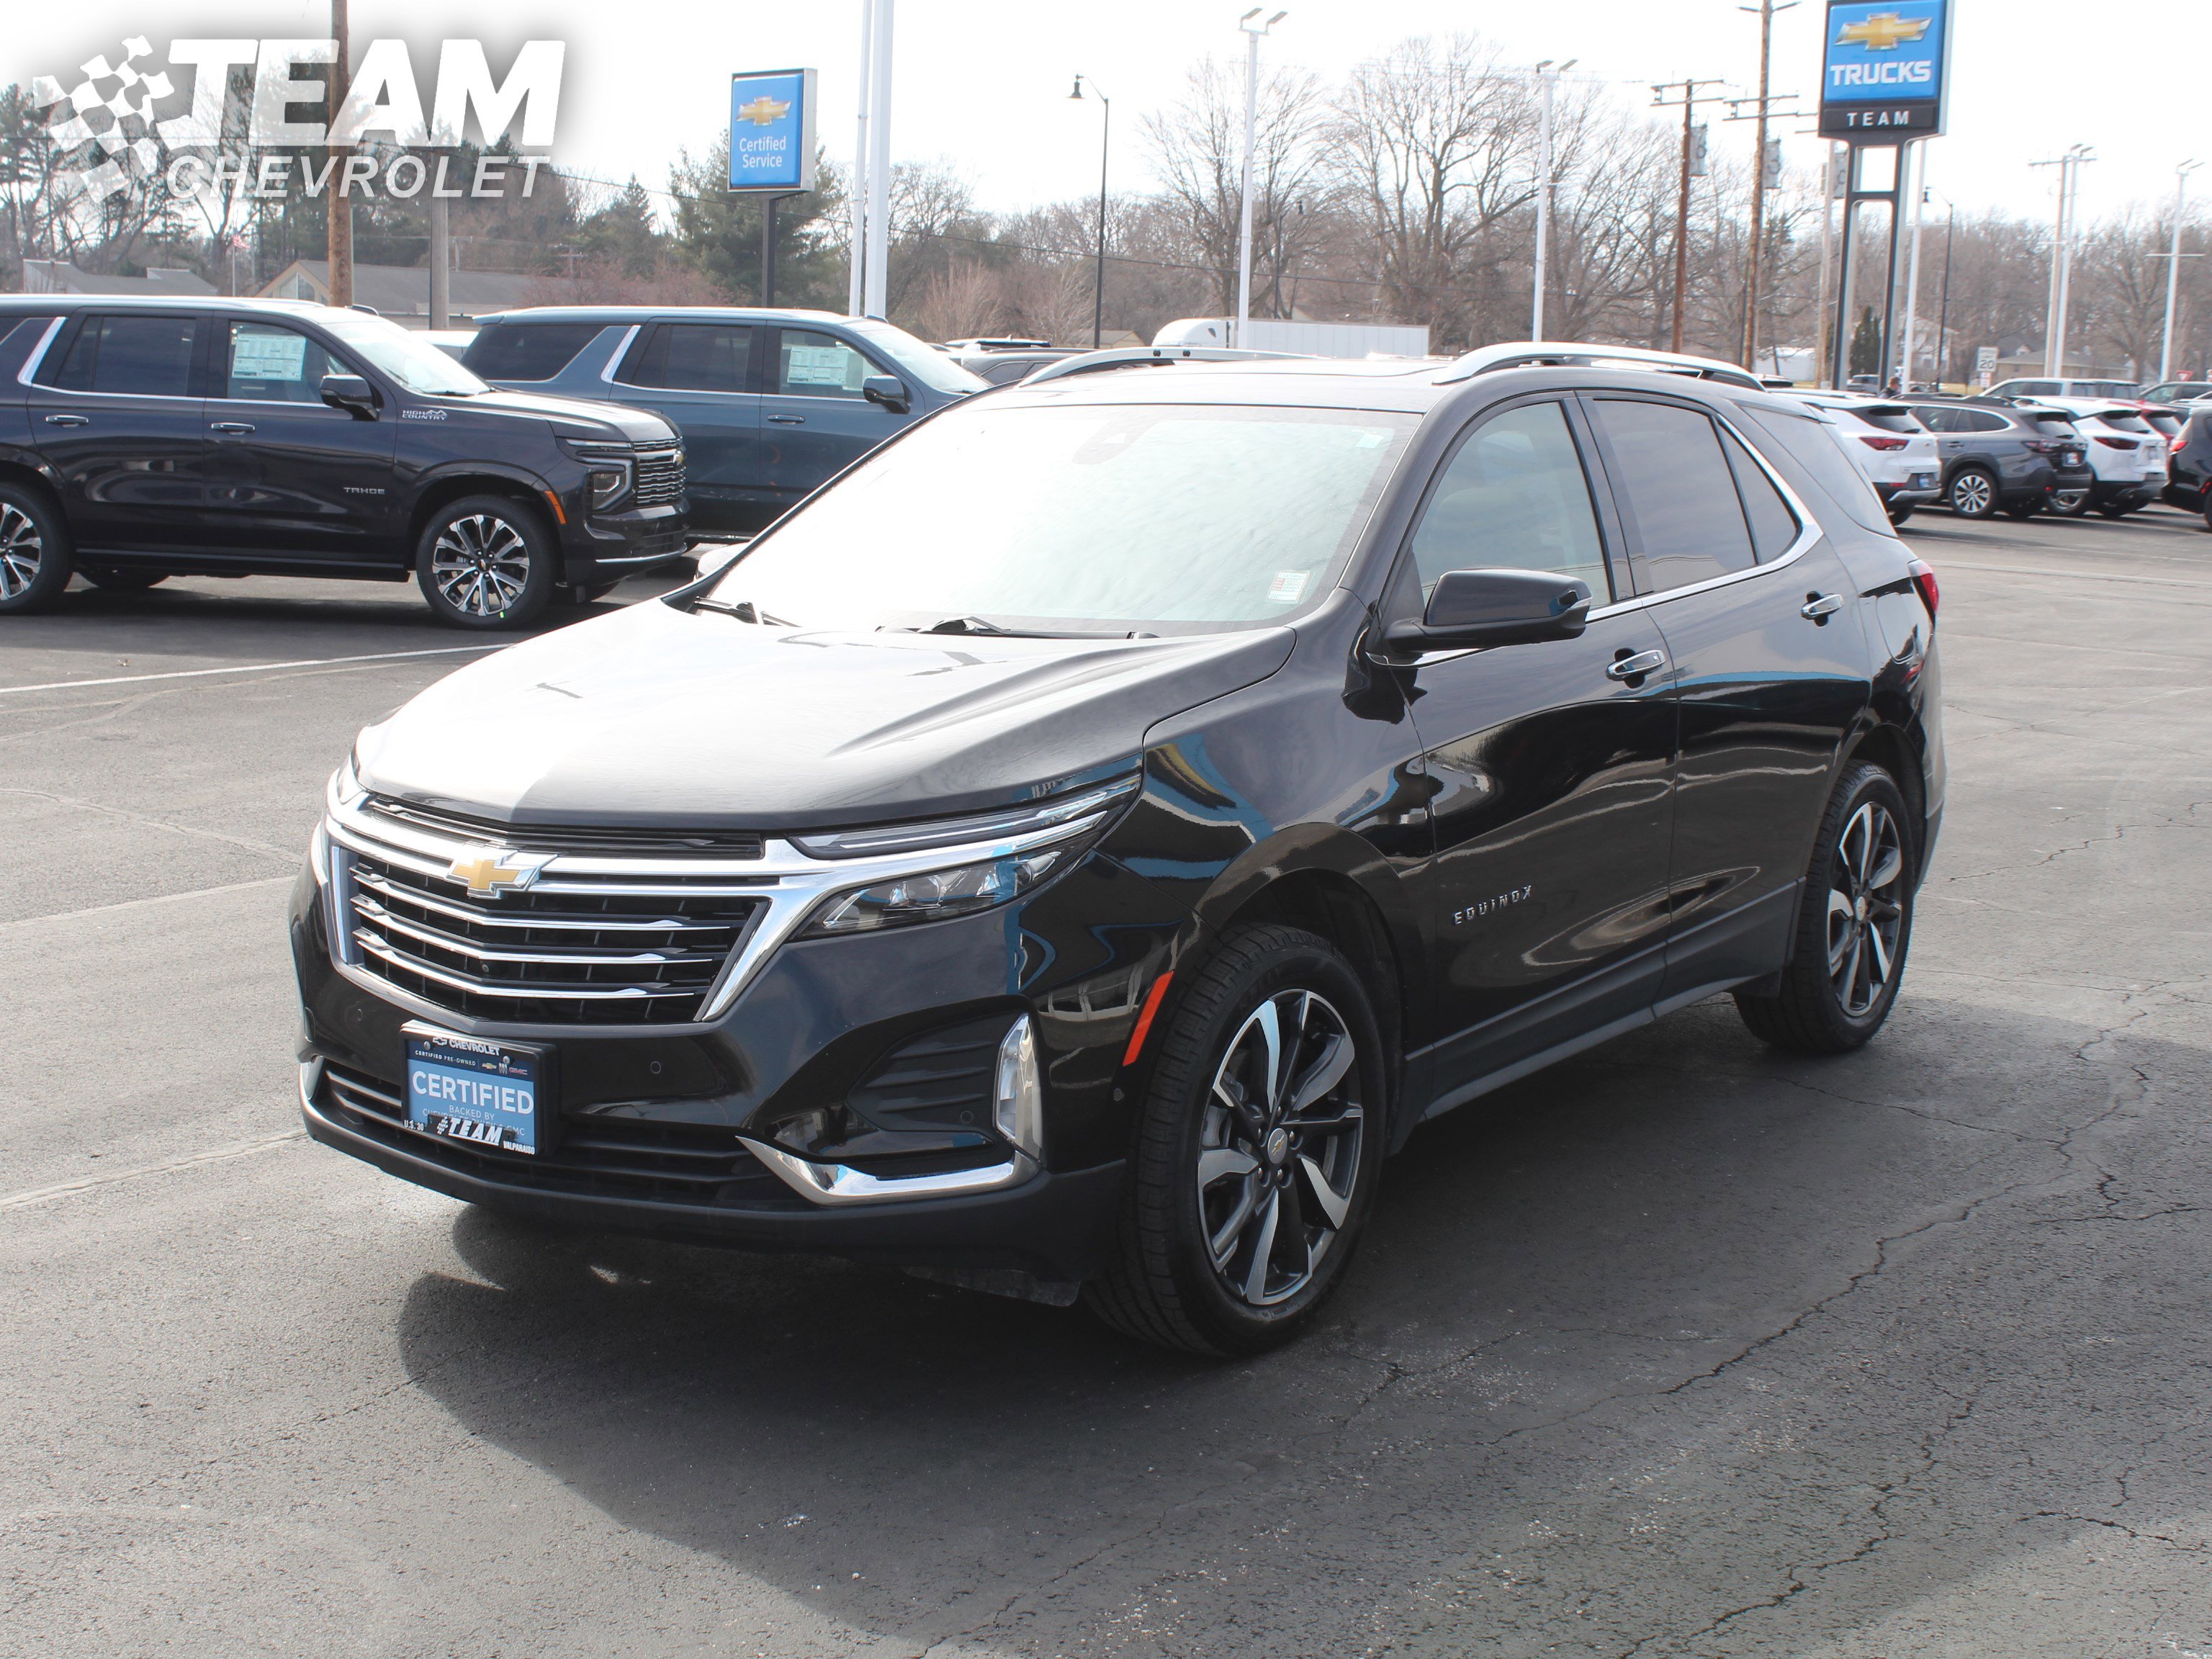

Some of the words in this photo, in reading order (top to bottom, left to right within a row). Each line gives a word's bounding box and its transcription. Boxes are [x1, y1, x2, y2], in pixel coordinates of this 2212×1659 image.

[1830, 60, 1932, 86] TRUCKS
[1846, 110, 1910, 127] TEAM
[739, 135, 786, 152] Certified
[742, 153, 783, 168] Service
[1979, 359, 1995, 369] 20
[1454, 885, 1532, 925] EQUINOX
[449, 1038, 500, 1056] CHEVROLET
[415, 1050, 442, 1060] CERTIFIED
[444, 1055, 476, 1066] PRE-OWNED
[413, 1071, 534, 1115] CERTIFIED
[449, 1105, 482, 1118] BACKED
[484, 1112, 495, 1121] BY
[404, 1119, 416, 1130] U.S.
[417, 1122, 424, 1131] 30
[448, 1117, 503, 1144] TEAM
[503, 1140, 536, 1155] VALPARAISO
